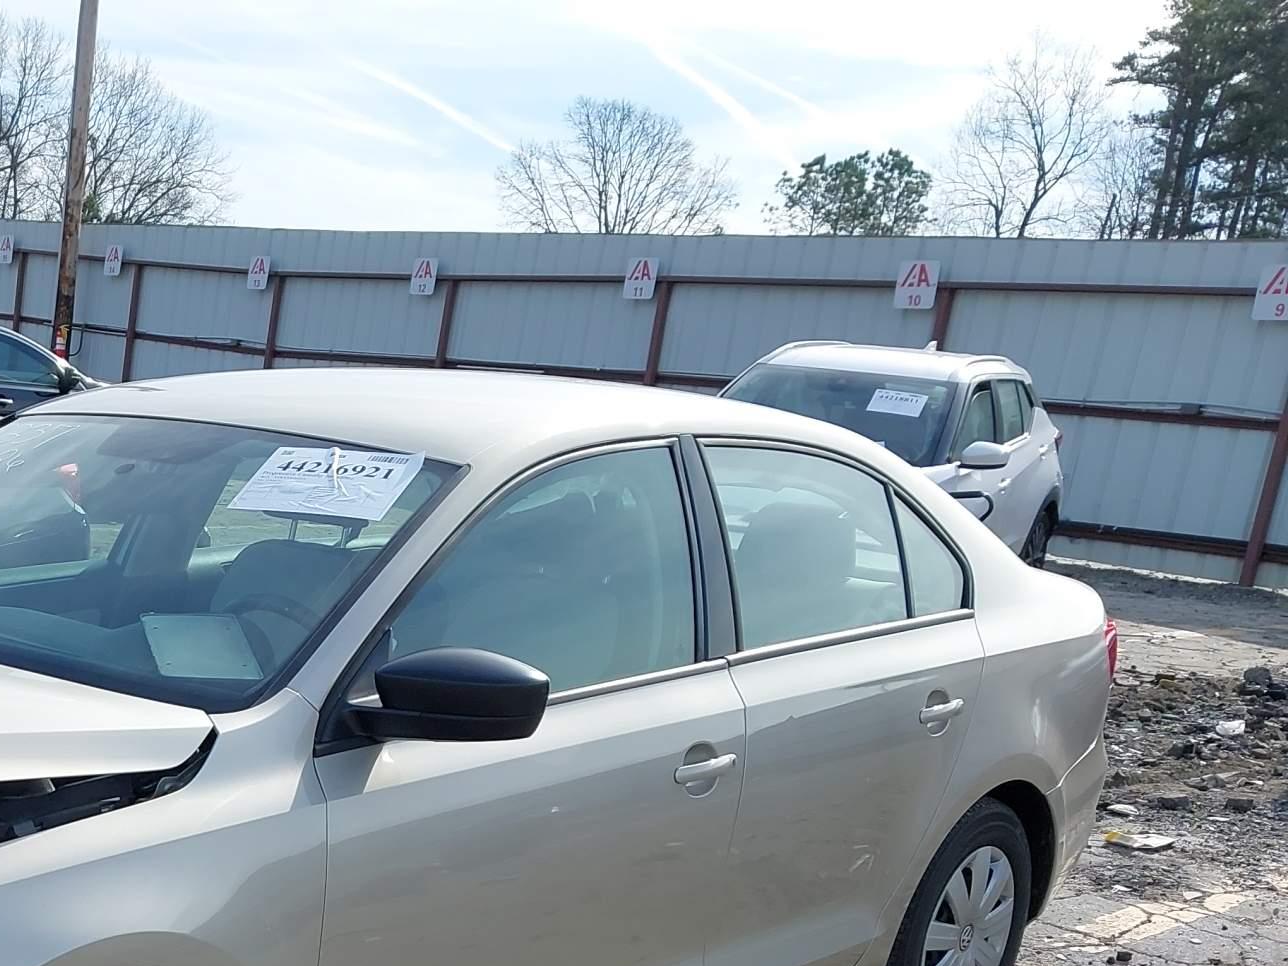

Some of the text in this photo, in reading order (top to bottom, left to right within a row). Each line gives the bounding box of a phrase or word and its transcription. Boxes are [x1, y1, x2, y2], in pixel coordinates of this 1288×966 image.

[418, 283, 427, 293] 12
[633, 286, 644, 297] 11
[908, 294, 921, 306] 10
[1274, 303, 1285, 317] 9
[276, 459, 396, 480] 44216921
